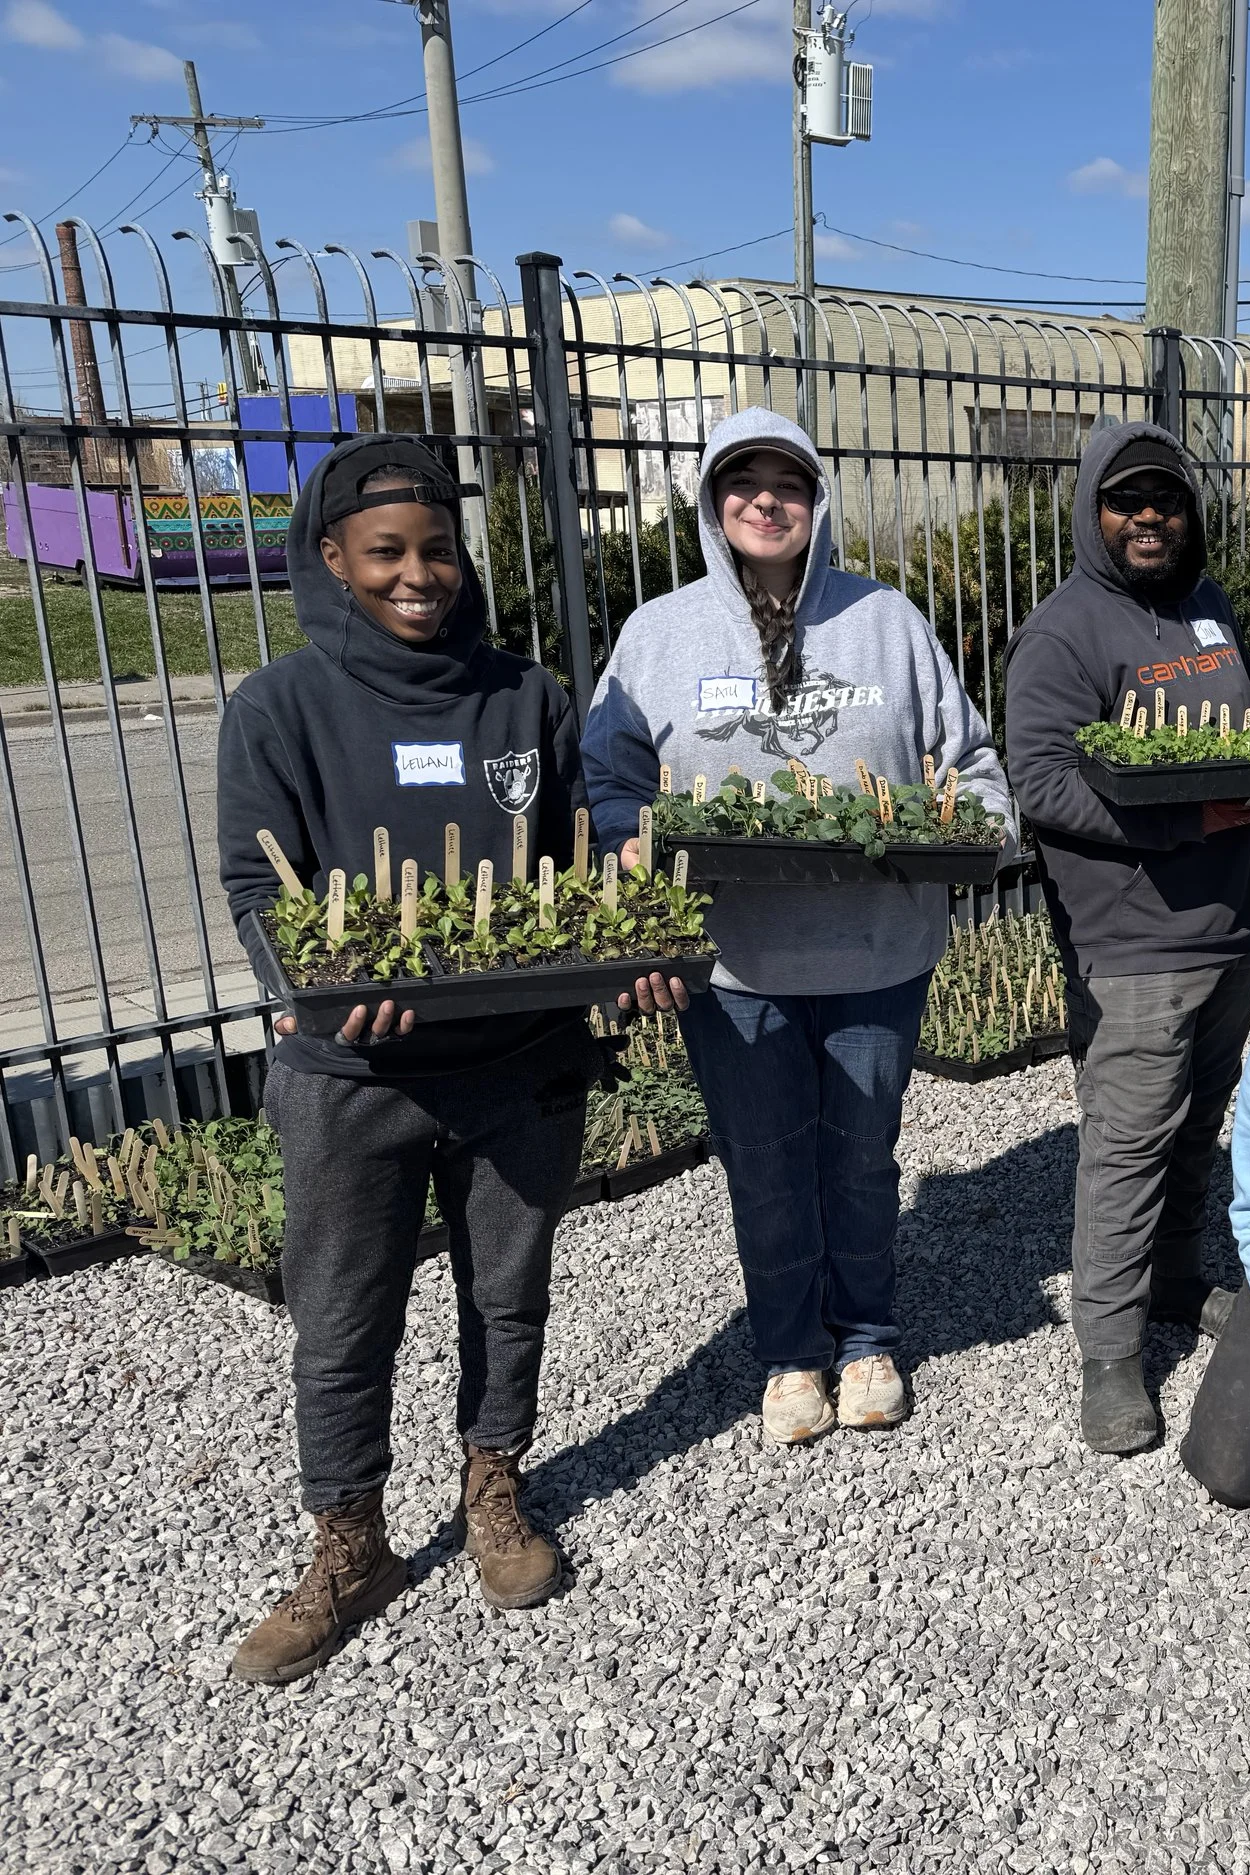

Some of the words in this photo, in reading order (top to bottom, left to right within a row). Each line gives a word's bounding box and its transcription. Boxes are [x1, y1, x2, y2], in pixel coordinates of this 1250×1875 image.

[1137, 647, 1240, 684] carhartt
[402, 755, 453, 771] LEILANI
[492, 756, 532, 771] RAIDERS
[261, 834, 281, 866] Lettuce
[332, 873, 342, 904] Lettuce
[404, 866, 414, 898] Lettuce
[480, 865, 490, 893] Lettuce
